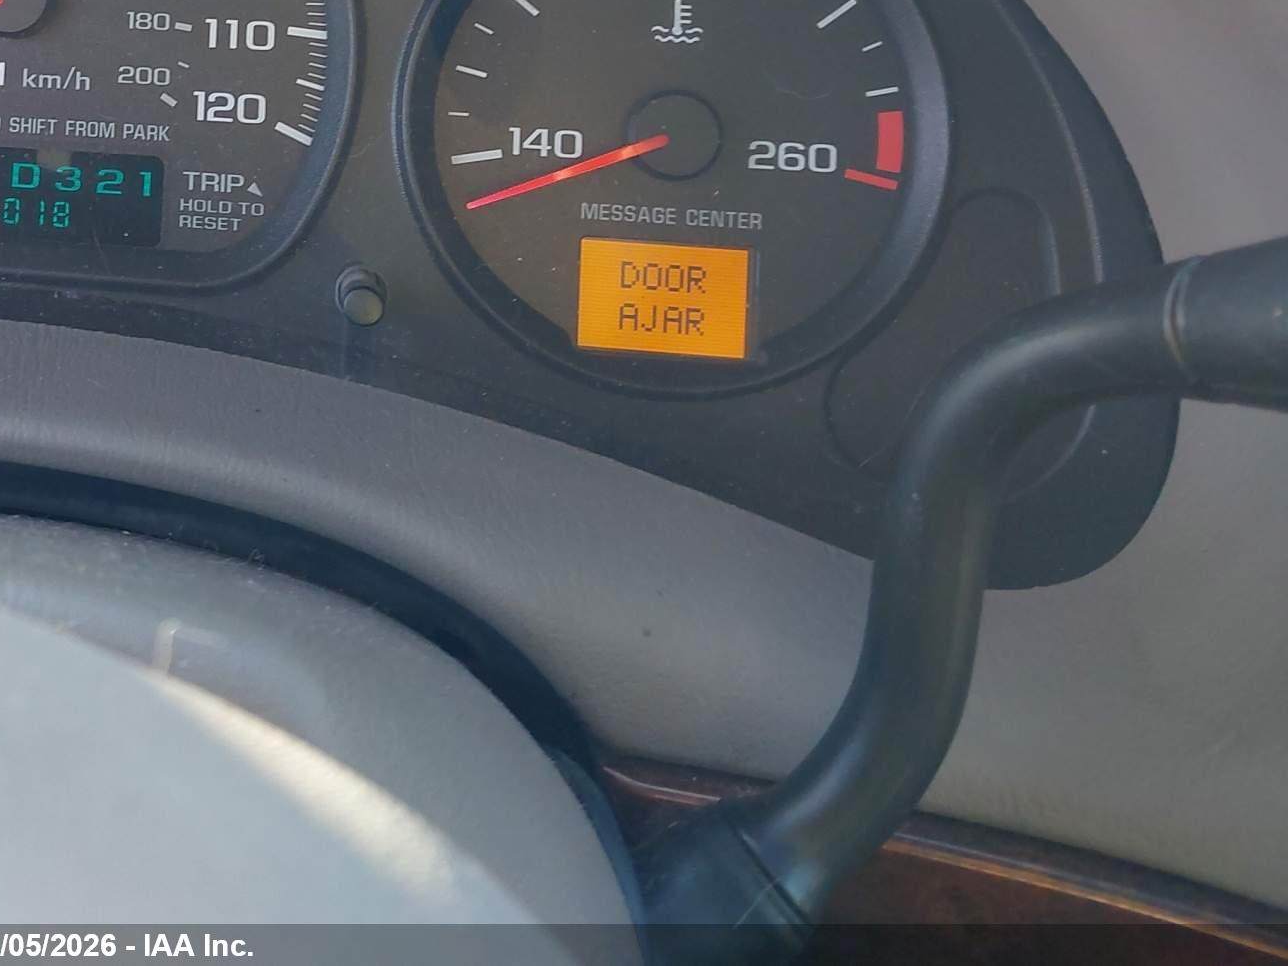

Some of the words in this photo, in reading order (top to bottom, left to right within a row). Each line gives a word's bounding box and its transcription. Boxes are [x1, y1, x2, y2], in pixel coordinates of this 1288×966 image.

[126, 12, 171, 31] 180
[204, 19, 276, 50] 110
[21, 67, 91, 93] km/h
[117, 66, 171, 85] 200
[192, 92, 267, 125] 120
[9, 116, 57, 135] SHIFT
[64, 120, 115, 138] FROM
[122, 123, 171, 142] PARK
[508, 126, 584, 159] 140
[747, 140, 838, 173] 260
[11, 162, 41, 189] D
[55, 166, 82, 191] 3
[95, 169, 125, 194] 2
[139, 171, 152, 197] 1
[182, 171, 244, 193] TRIP
[179, 199, 231, 214] HOLD
[239, 202, 264, 216] TO
[580, 202, 677, 225] MESSAGE
[685, 208, 763, 230] CENTER
[178, 215, 241, 232] RESET
[620, 260, 708, 294] DOOR
[618, 302, 706, 336] AJAR
